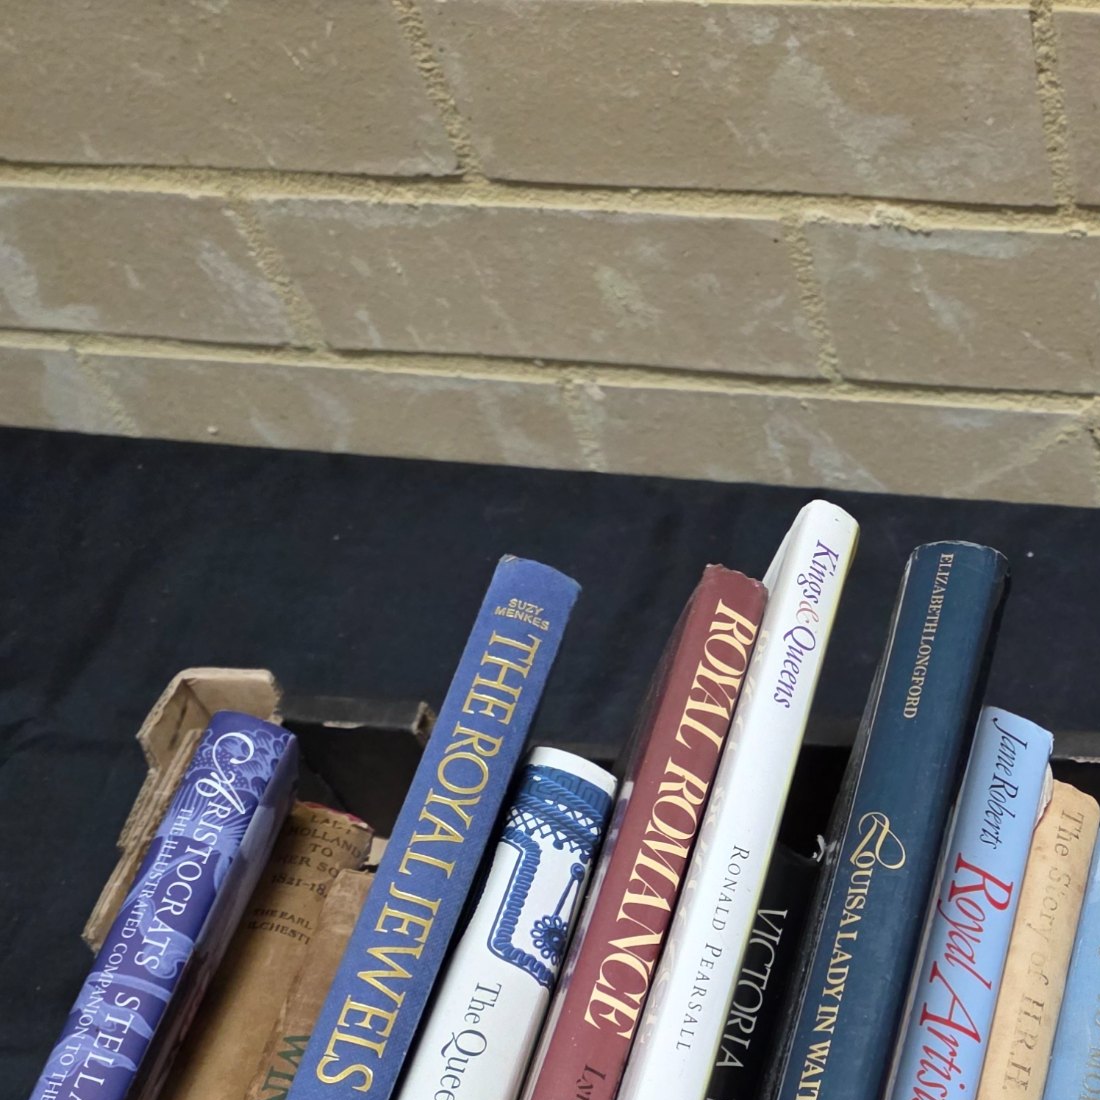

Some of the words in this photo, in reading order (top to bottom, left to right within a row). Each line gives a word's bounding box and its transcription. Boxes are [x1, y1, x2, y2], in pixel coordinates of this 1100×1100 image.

[507, 598, 544, 615] SUZY
[797, 539, 840, 604] Kings
[923, 552, 954, 633] ELIZABETH
[495, 606, 549, 631] MENKES
[462, 630, 542, 725] THE
[675, 598, 758, 753] ROYAL
[774, 626, 816, 708] Queens
[903, 633, 934, 719] LONGFORD
[992, 717, 1028, 776] Jane
[167, 807, 193, 840] THE
[399, 721, 503, 879] ROYAL
[980, 772, 1019, 850] Roberts
[1055, 810, 1084, 857] The
[121, 840, 178, 939] ILLUSTRATED
[134, 732, 254, 971] ARISTOCRATS
[309, 843, 333, 857] TO
[712, 845, 750, 931] RONALD
[584, 757, 709, 1040] ROMANCE
[937, 853, 1014, 990] Royal
[72, 942, 128, 1040] COMPANION
[317, 882, 441, 1092] JEWELS
[464, 982, 502, 1024] The
[676, 942, 722, 1051] PEARSALL
[716, 908, 788, 1068] VICTORIA
[822, 931, 858, 1001] LADY
[1031, 951, 1050, 986] of
[60, 1043, 82, 1067] TO
[812, 1003, 842, 1034] IN
